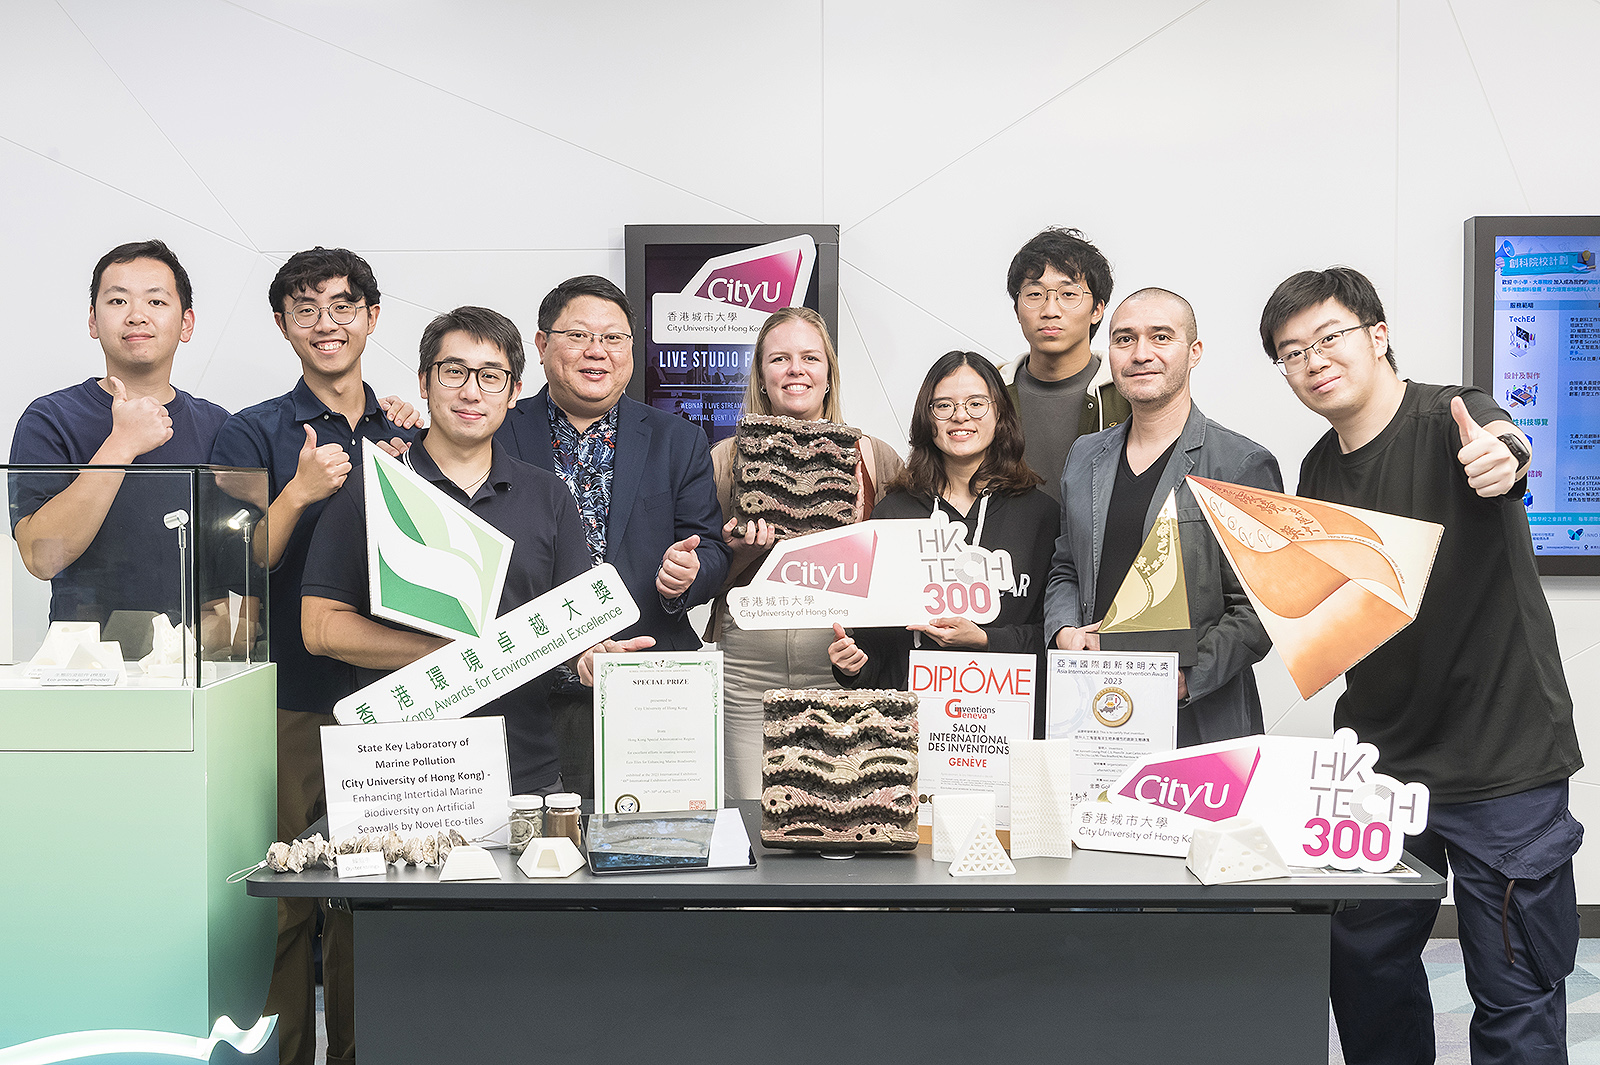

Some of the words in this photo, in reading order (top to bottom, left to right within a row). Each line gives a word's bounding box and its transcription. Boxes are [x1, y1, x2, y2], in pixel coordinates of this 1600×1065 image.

[708, 278, 782, 308] CityU
[668, 311, 738, 322] 香港城市大學
[667, 324, 683, 333] City
[683, 324, 718, 333] University
[660, 351, 687, 367] LIVE
[693, 351, 738, 367] STUDIO
[780, 560, 858, 591] CityU
[740, 595, 814, 607] 香港城市大學
[922, 582, 991, 615] 300
[740, 609, 756, 619] City
[757, 609, 794, 618] University
[806, 609, 826, 617] Hong
[828, 608, 848, 616] Kong
[434, 685, 476, 712] Awards
[475, 675, 492, 690] for
[492, 630, 568, 681] Environmental
[568, 605, 623, 641] Excellence
[912, 660, 1031, 696] DIPLÔME
[954, 704, 996, 714] inventions
[953, 723, 986, 734] SALON
[358, 744, 382, 753] State
[385, 743, 403, 752] Key
[406, 738, 457, 750] Laboratory
[459, 738, 470, 747] of
[930, 732, 1008, 745] INTERNATIONAL
[928, 742, 946, 752] DES
[948, 743, 1010, 755] INVENTIONS
[376, 758, 410, 769] Marine
[412, 756, 455, 766] Pollution
[948, 756, 987, 768] GENÈVE
[342, 779, 364, 790] (City
[366, 776, 415, 788] University
[418, 774, 428, 783] of
[430, 773, 455, 783] Hong
[458, 770, 485, 781] Kong)
[353, 792, 402, 803] Enhancing
[404, 788, 448, 798] Intertidal
[450, 786, 483, 796] Marine
[1134, 774, 1230, 814] CityU
[364, 806, 419, 818] Biodiversity
[422, 804, 434, 814] on
[436, 802, 475, 812] Artificial
[358, 823, 399, 834] Seawalls
[401, 822, 413, 832] by
[415, 819, 443, 829] Novel
[445, 816, 484, 827] Eco-tiles
[1081, 812, 1168, 828] 香港城市大學
[1079, 826, 1096, 838] City
[1098, 828, 1140, 841] University
[1143, 831, 1153, 840] of
[1155, 833, 1179, 844] Hong
[1302, 818, 1391, 861] 300
